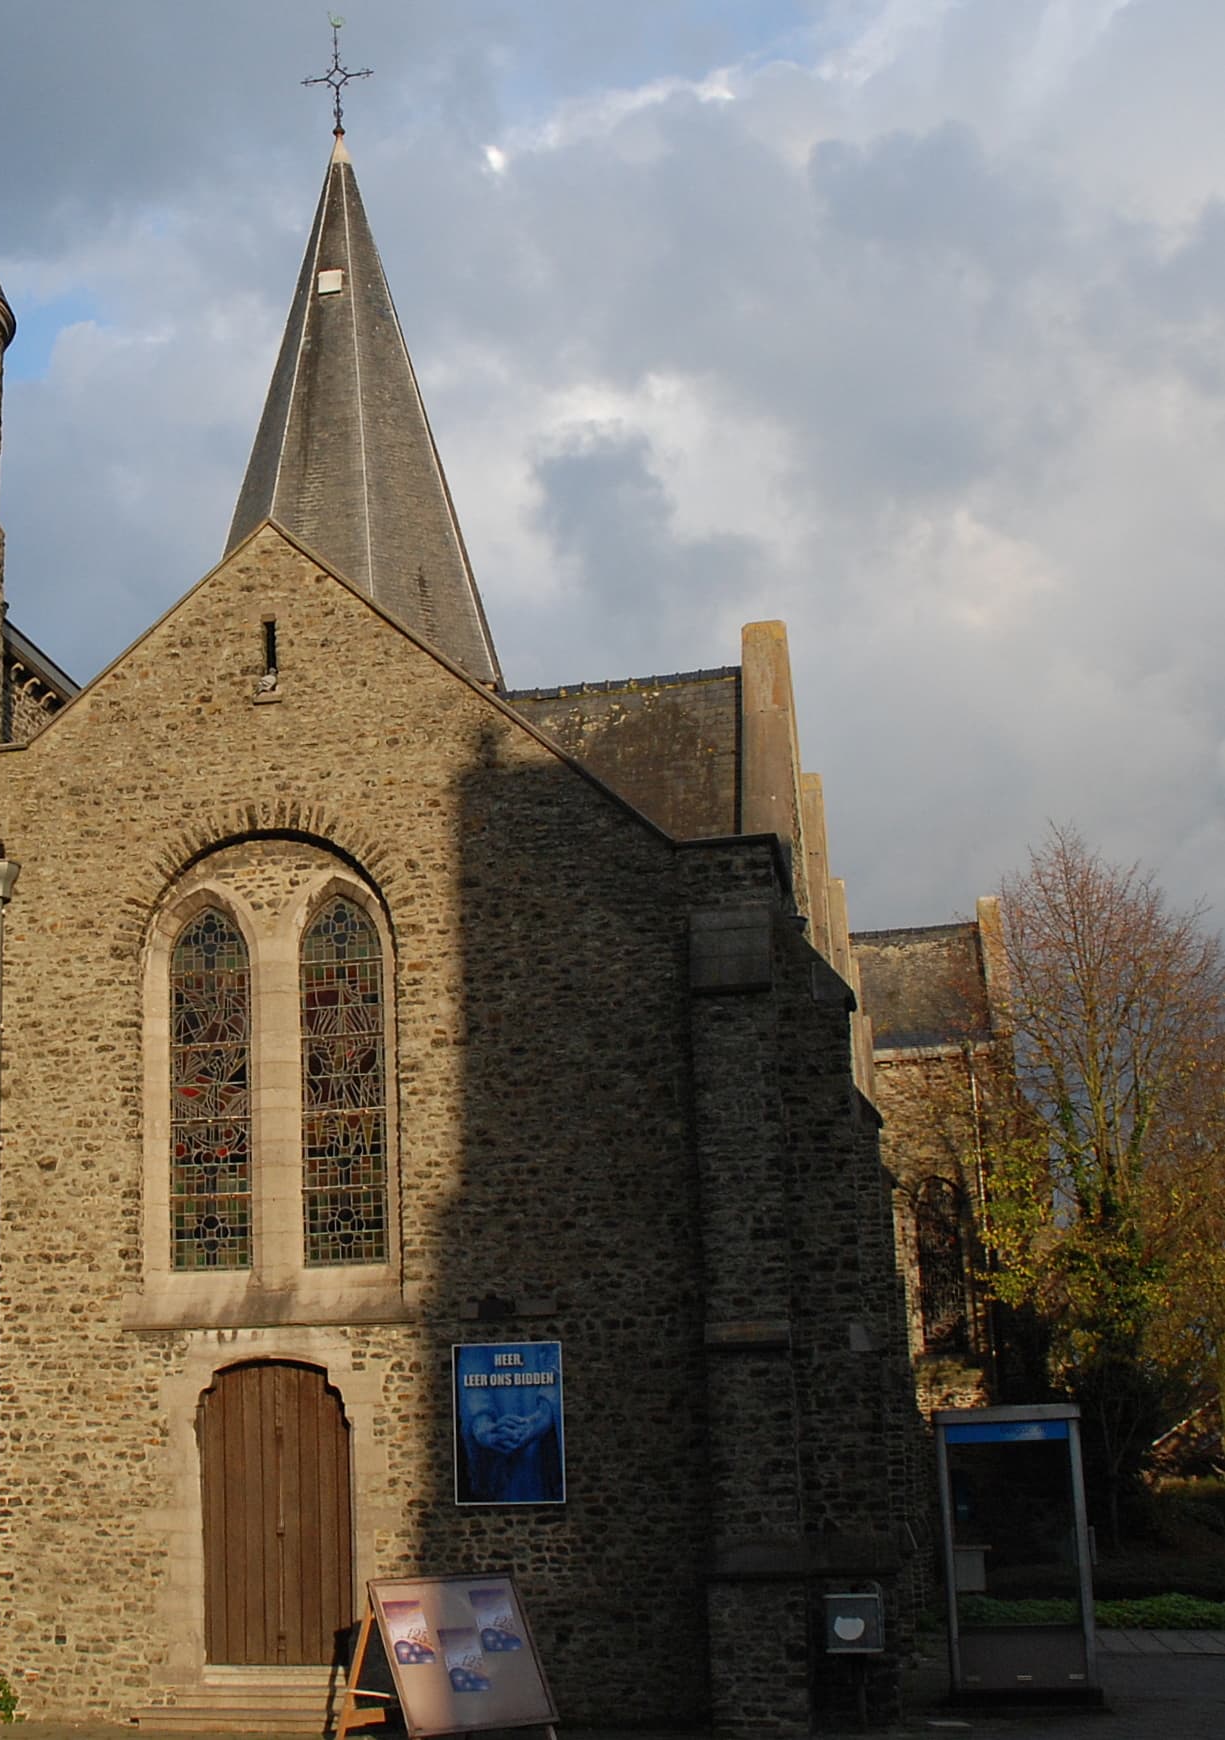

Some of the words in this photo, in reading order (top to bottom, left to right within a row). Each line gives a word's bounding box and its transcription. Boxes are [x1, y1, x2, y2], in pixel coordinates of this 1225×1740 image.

[494, 1353, 524, 1367] HEER,
[464, 1374, 488, 1387] LEER
[490, 1373, 512, 1386] ONS
[514, 1372, 554, 1386] BIDDEN
